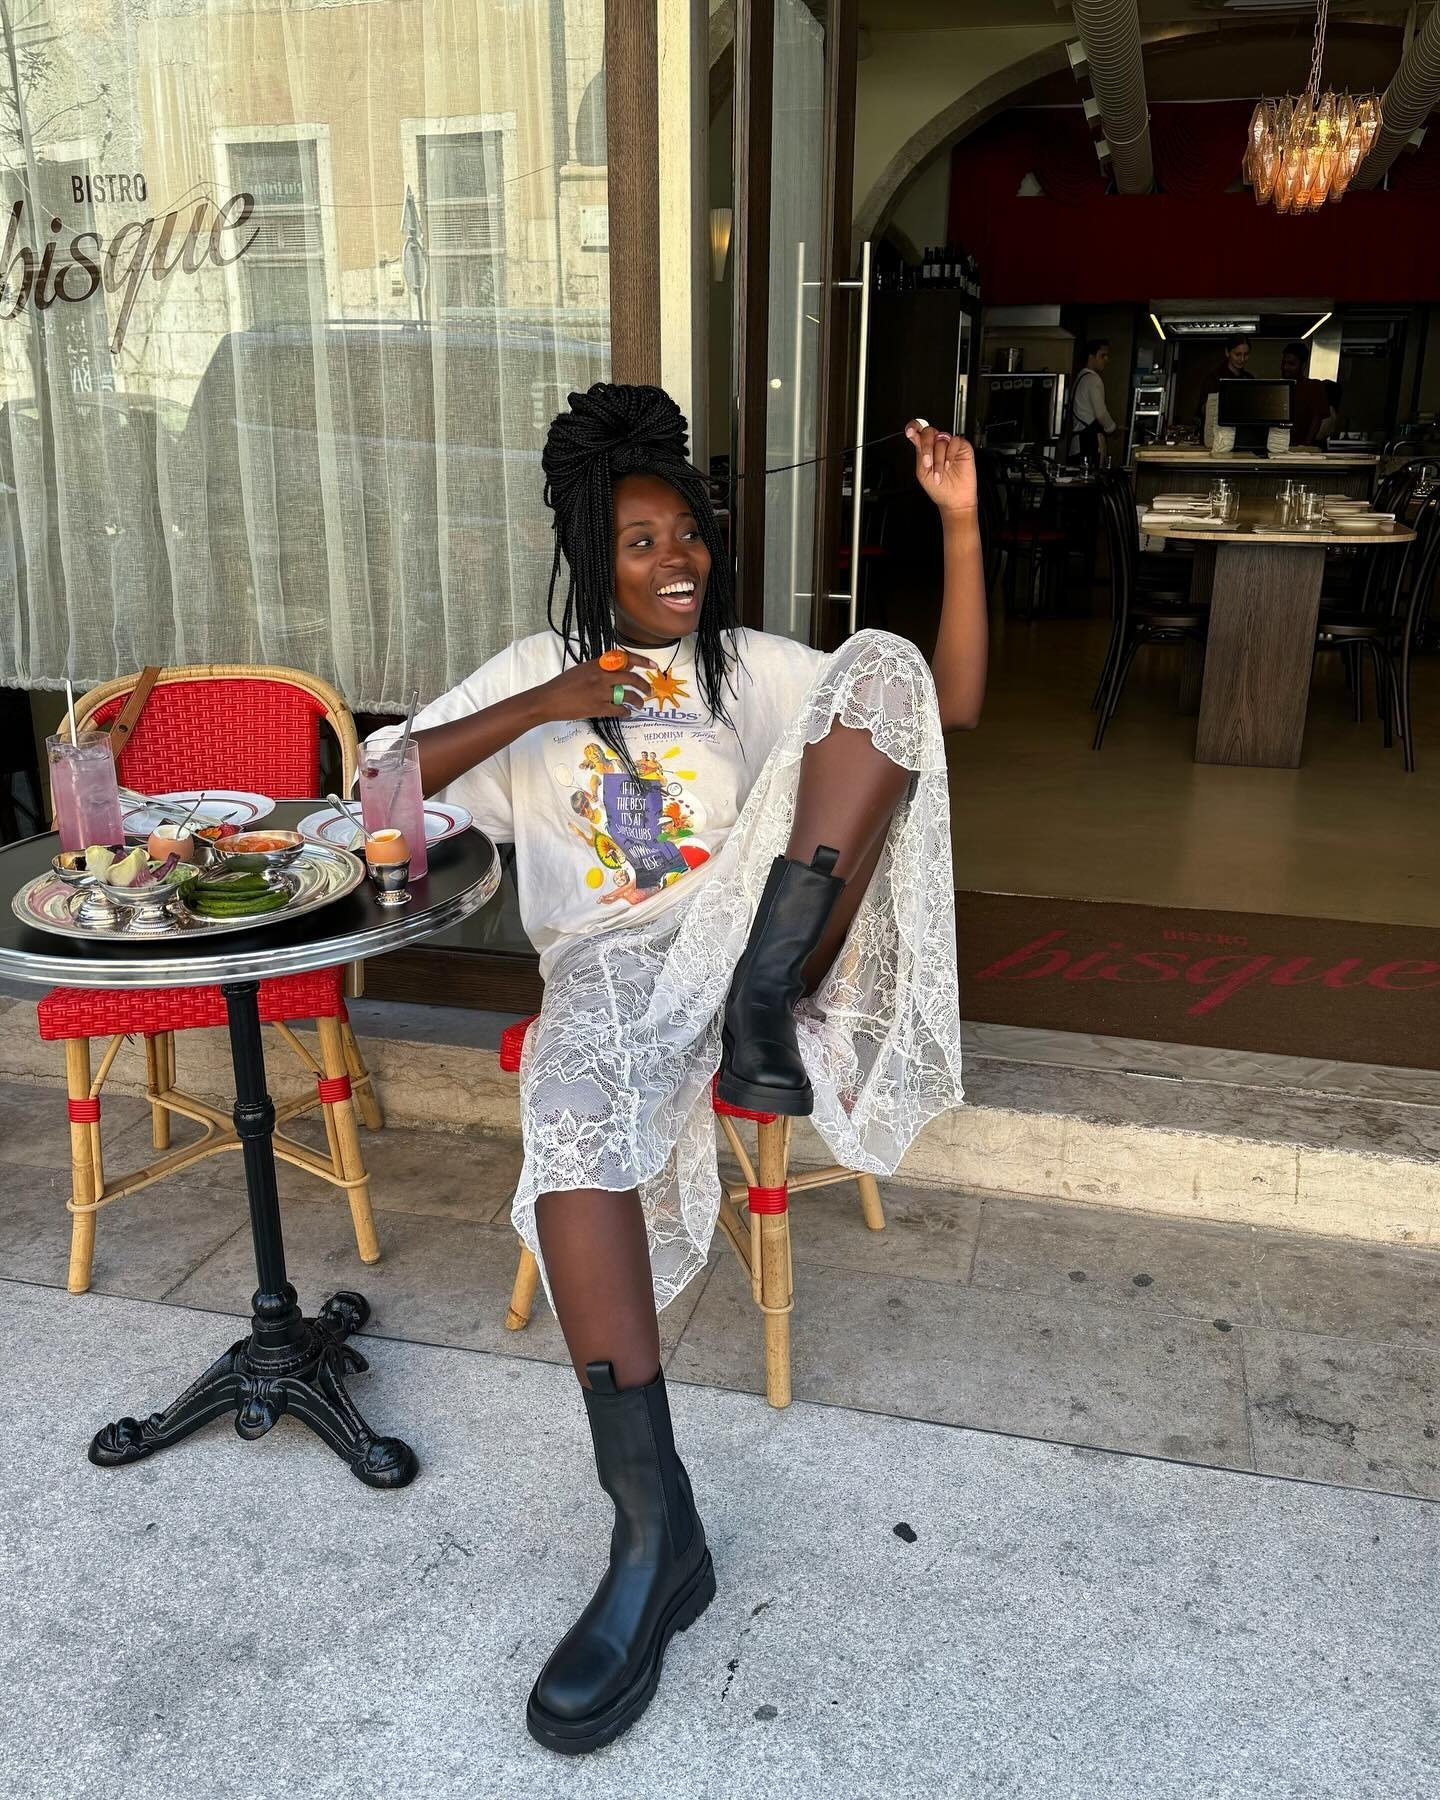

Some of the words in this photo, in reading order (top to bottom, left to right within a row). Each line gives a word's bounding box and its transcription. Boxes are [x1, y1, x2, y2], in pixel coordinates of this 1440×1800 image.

[71, 173, 147, 203] BISTRO
[0, 192, 260, 354] bisque
[643, 706, 698, 720] lubs
[644, 731, 683, 741] HEDONISM
[617, 797, 629, 810] THE
[630, 797, 646, 810] BEST
[633, 812, 642, 826] AT
[1162, 928, 1249, 945] BISTRO
[975, 929, 1440, 1016] bisque
